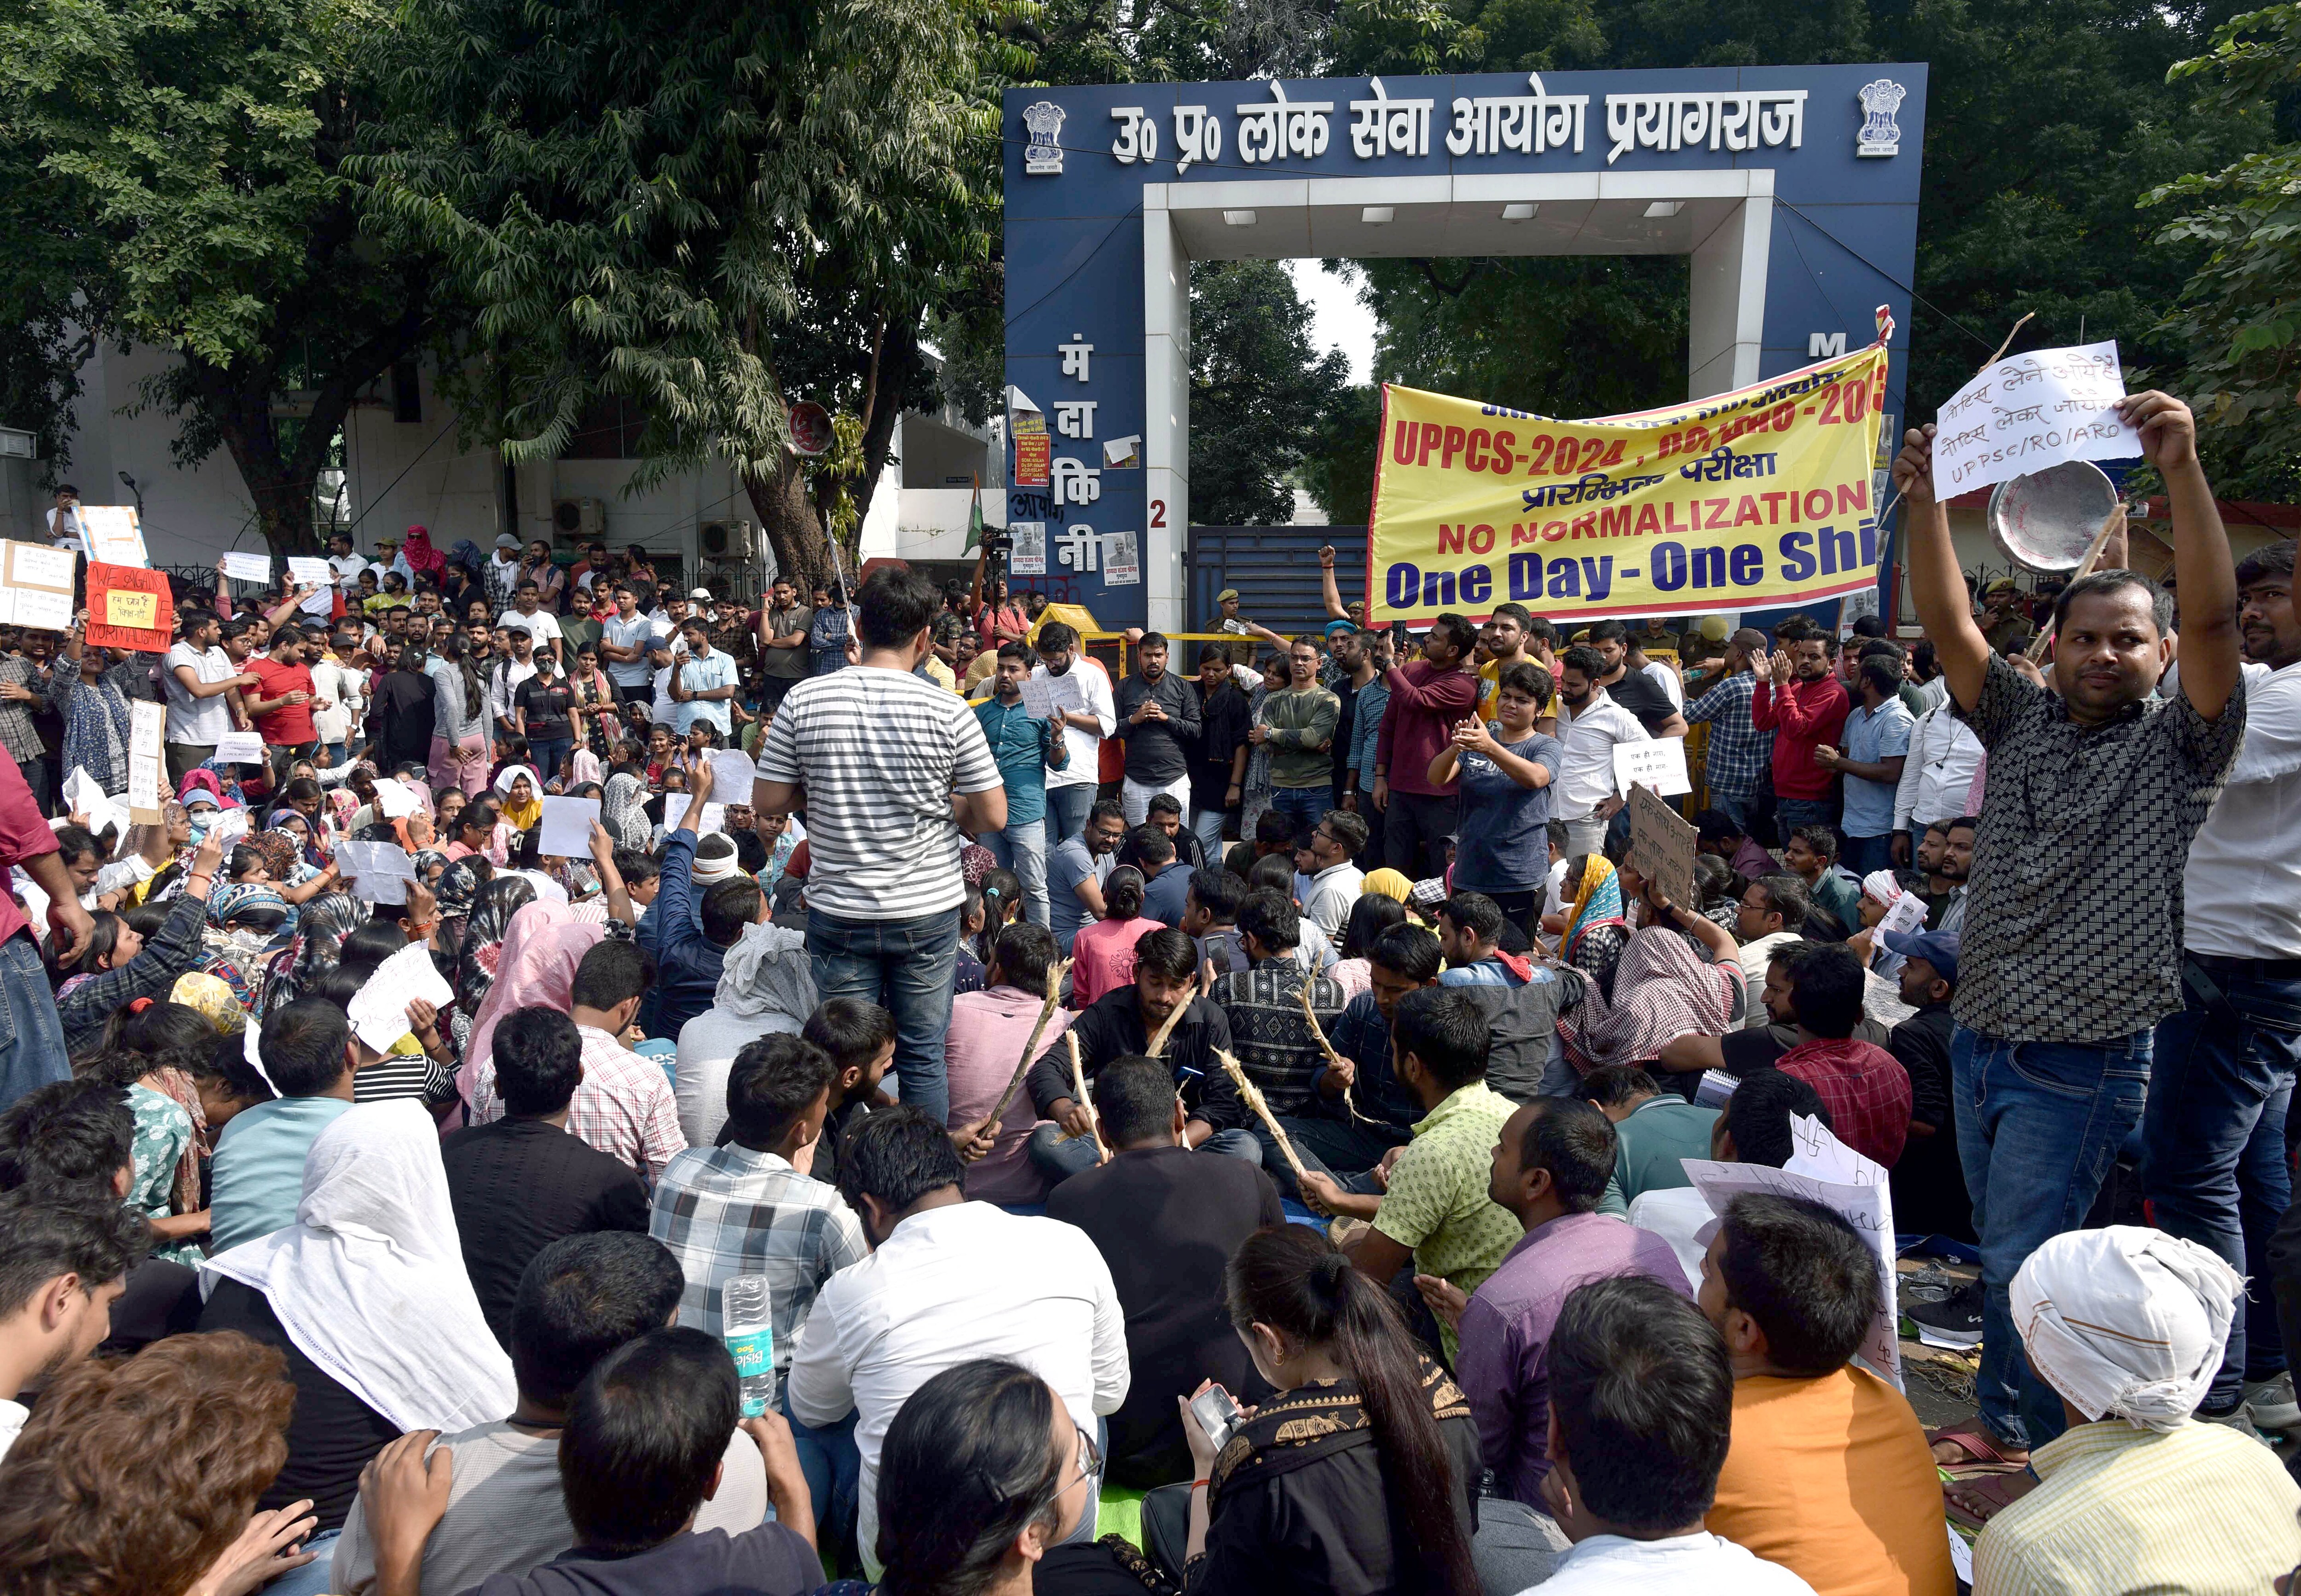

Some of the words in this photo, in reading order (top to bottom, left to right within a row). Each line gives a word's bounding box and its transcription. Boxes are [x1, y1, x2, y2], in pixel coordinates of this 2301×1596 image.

[1237, 79, 1334, 164] लोक
[1350, 76, 1434, 159] सेवा
[1445, 71, 1590, 157] आयोग
[1604, 89, 1809, 167] प्रयागराज
[1944, 383, 1992, 423] नोटिस
[1941, 423, 1990, 457] नोटिस
[1991, 403, 2051, 431] लेकर
[1679, 446, 1778, 482] परीक्षा
[1150, 500, 1166, 528] 2
[1437, 524, 1496, 555] NO
[1511, 479, 1868, 548] NORMALIZATION
[92, 565, 120, 587] WE
[1386, 562, 1492, 609] One
[112, 596, 122, 605] हम
[126, 597, 140, 606] छात्र
[1643, 750, 1650, 759] ही
[1646, 764, 1653, 772] ही
